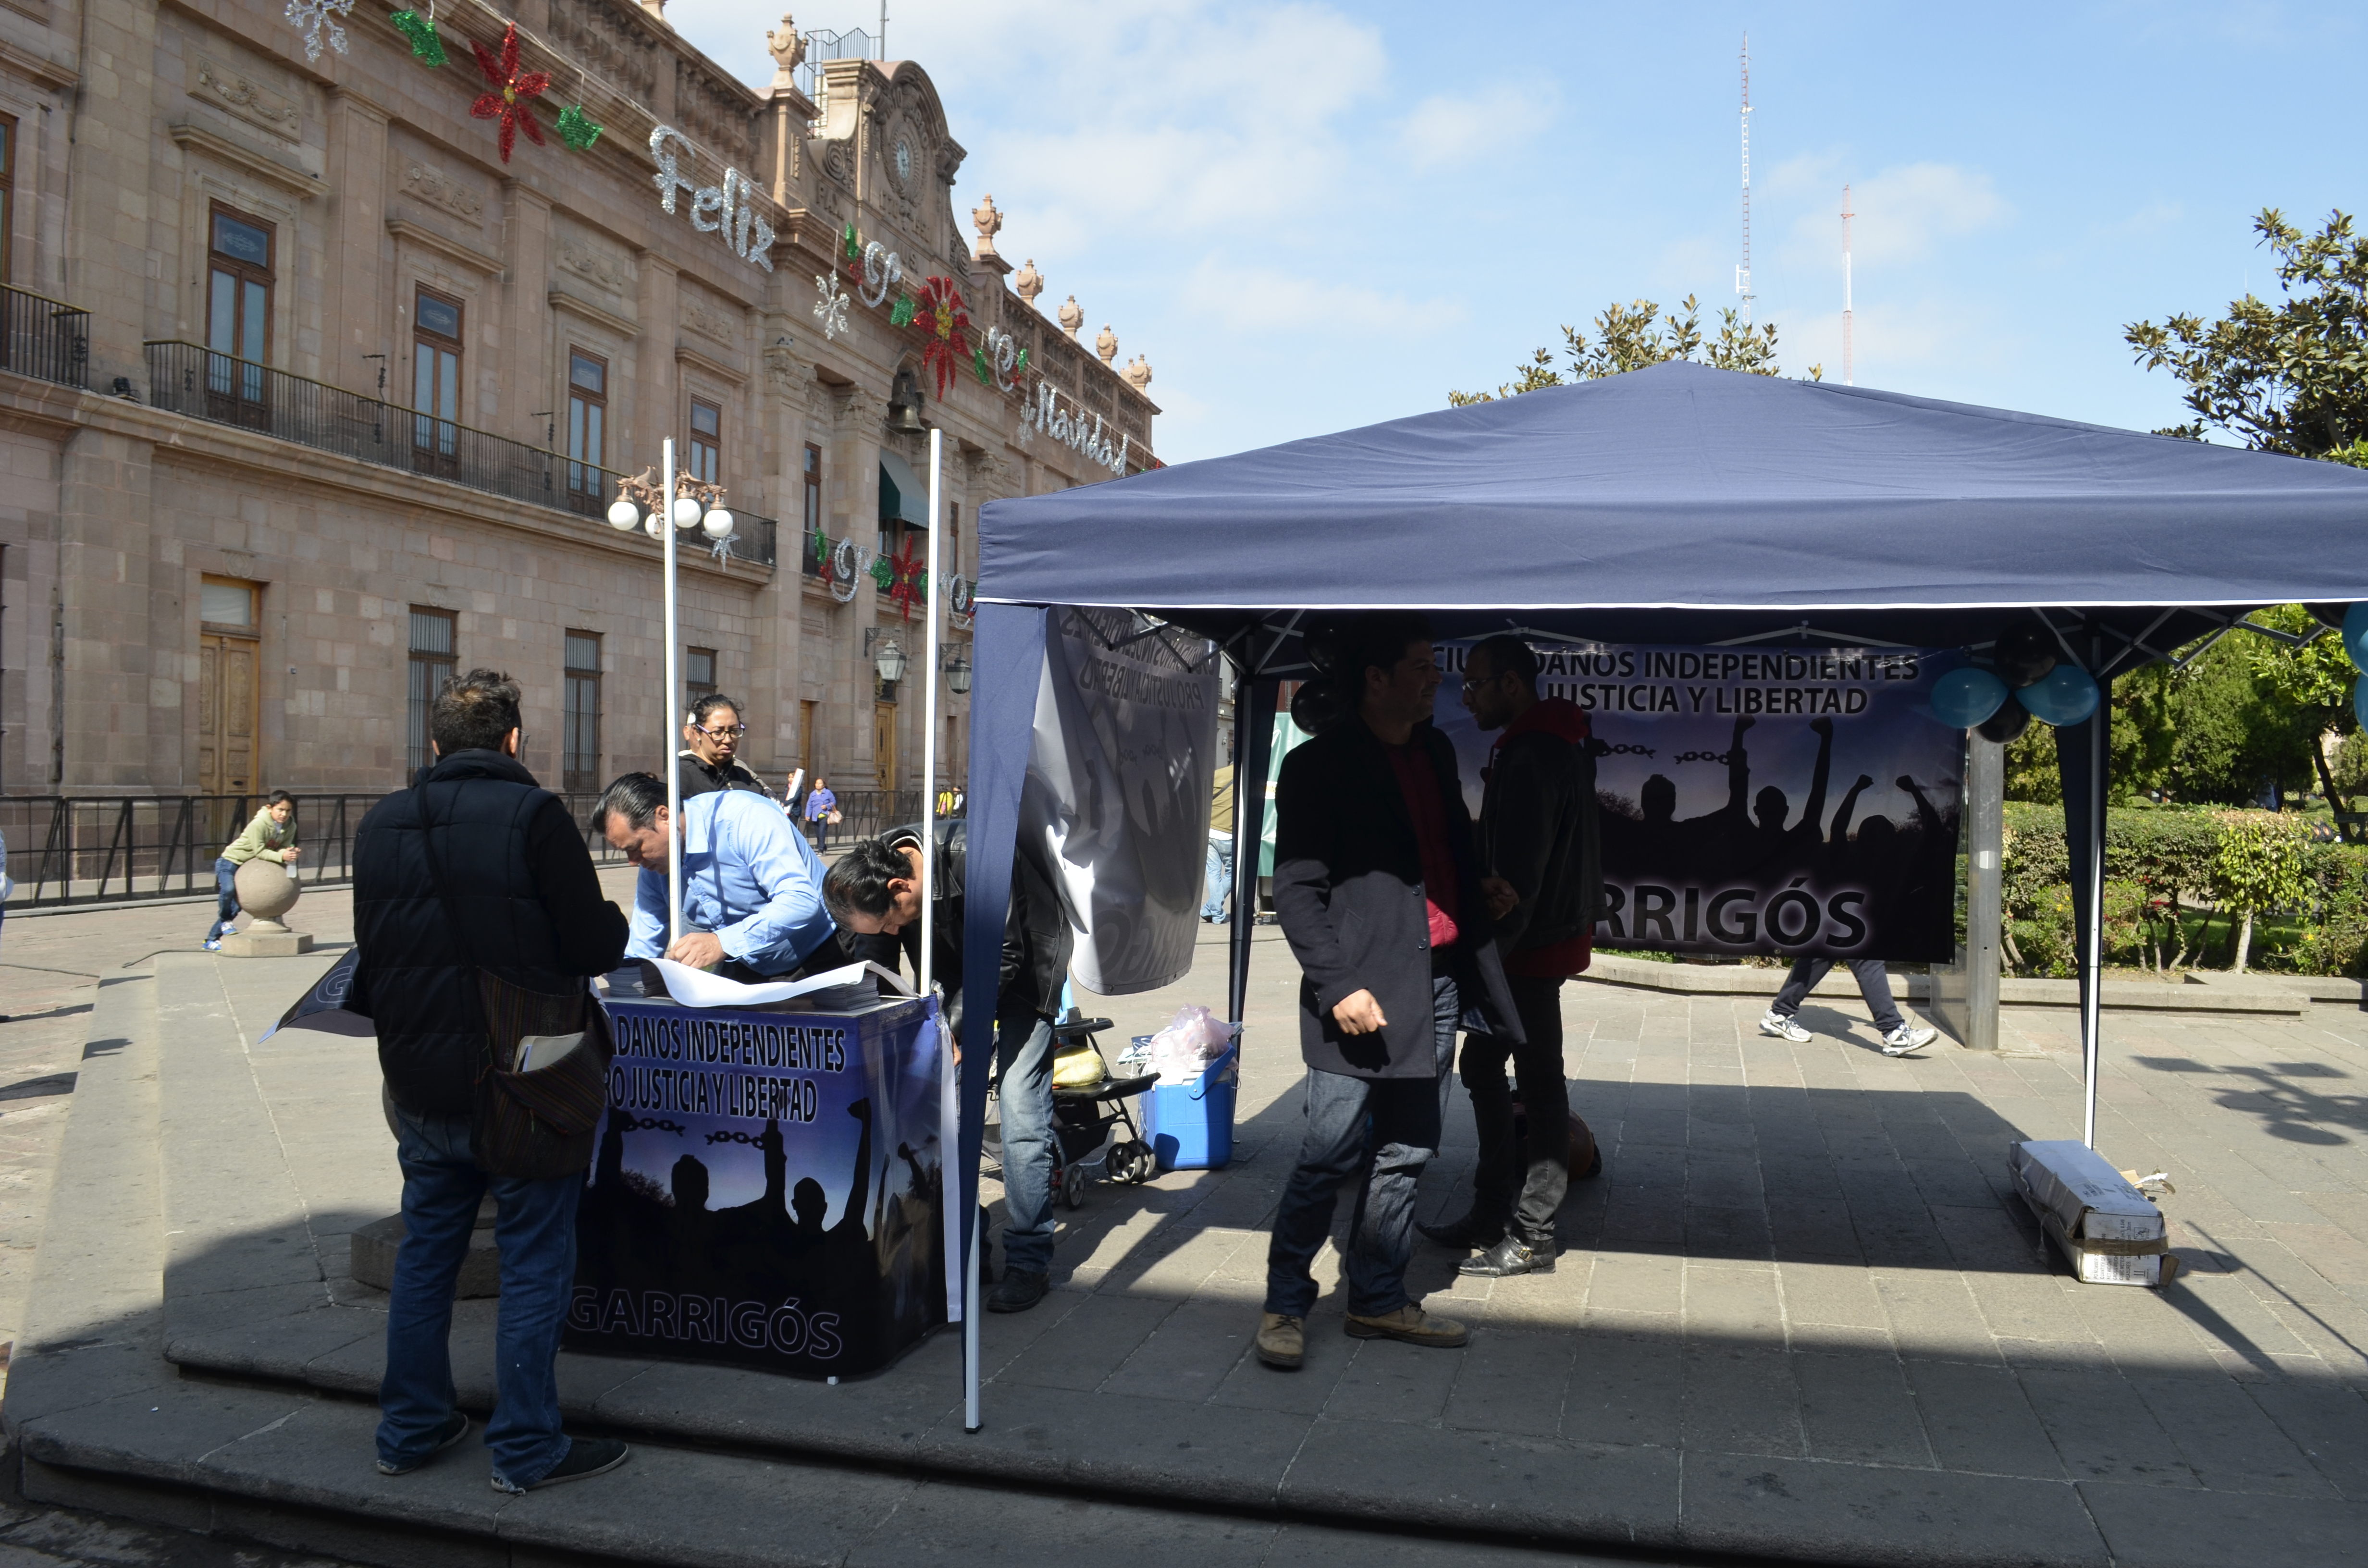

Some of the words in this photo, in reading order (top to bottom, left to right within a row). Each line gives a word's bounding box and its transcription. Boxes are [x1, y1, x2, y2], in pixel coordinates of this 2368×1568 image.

[1036, 382, 1128, 477] Navidad
[1644, 652, 1919, 681] INDEPENDIENTES
[1681, 685, 1707, 712] Y
[1716, 686, 1868, 715] LIBERTAD
[1593, 877, 1865, 948] RRIGÓS
[613, 1016, 681, 1060] DANOS
[686, 1020, 845, 1072] INDEPENDIENTES
[605, 1066, 625, 1107] RO
[630, 1067, 710, 1114] JUSTICIA
[712, 1073, 724, 1114] Y
[729, 1074, 817, 1123] LIBERTAD
[566, 1286, 842, 1360] GARRIGÓS
